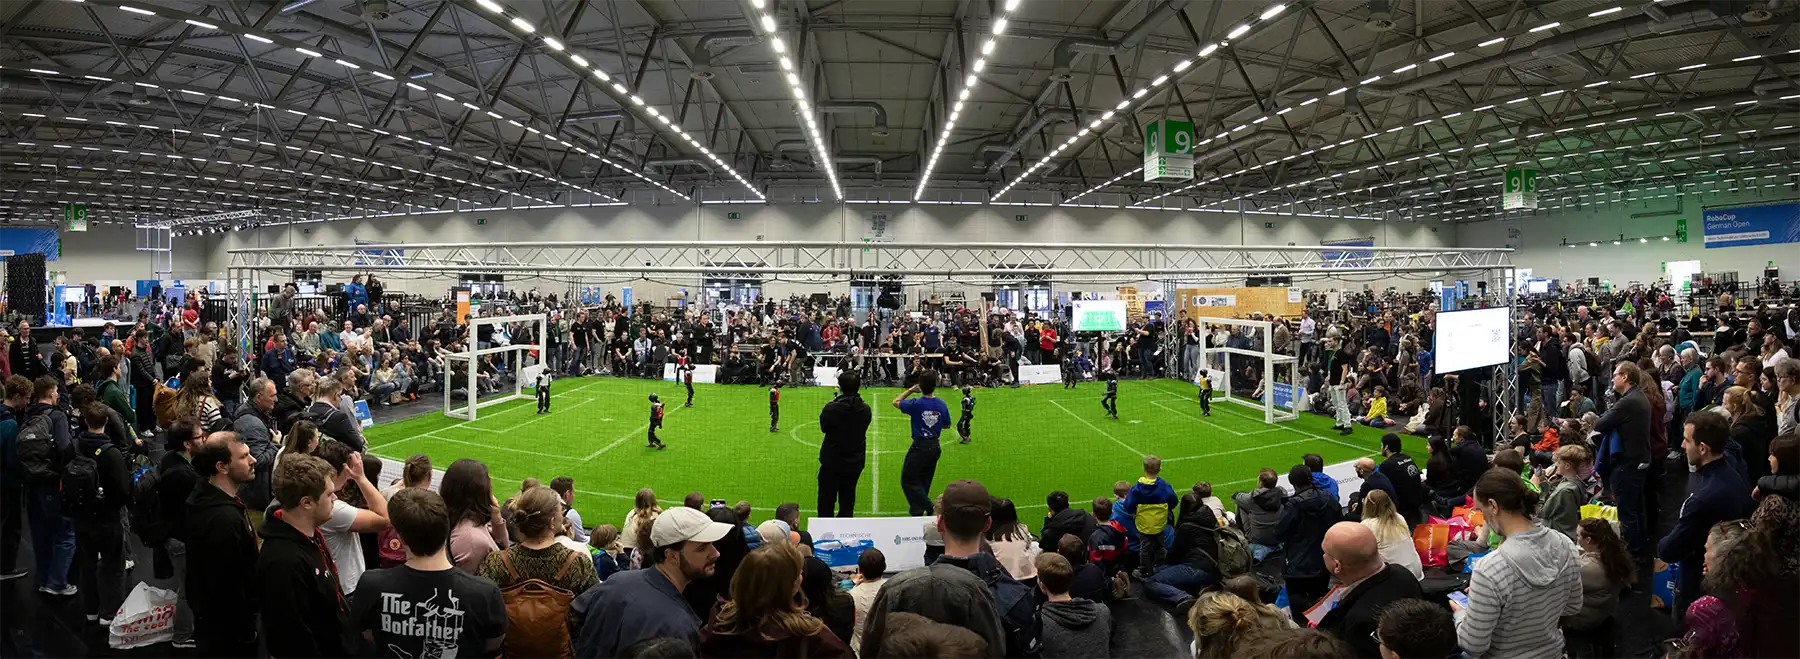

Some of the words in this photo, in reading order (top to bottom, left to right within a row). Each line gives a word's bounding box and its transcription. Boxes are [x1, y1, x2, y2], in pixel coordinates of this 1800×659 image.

[1151, 132, 1158, 154] 9
[1175, 131, 1190, 154] 9
[1511, 176, 1520, 192] 9
[1529, 177, 1535, 192] 9
[78, 210, 85, 221] 9
[380, 592, 411, 615] The
[144, 618, 168, 630] cool
[380, 613, 464, 641] Botfather
